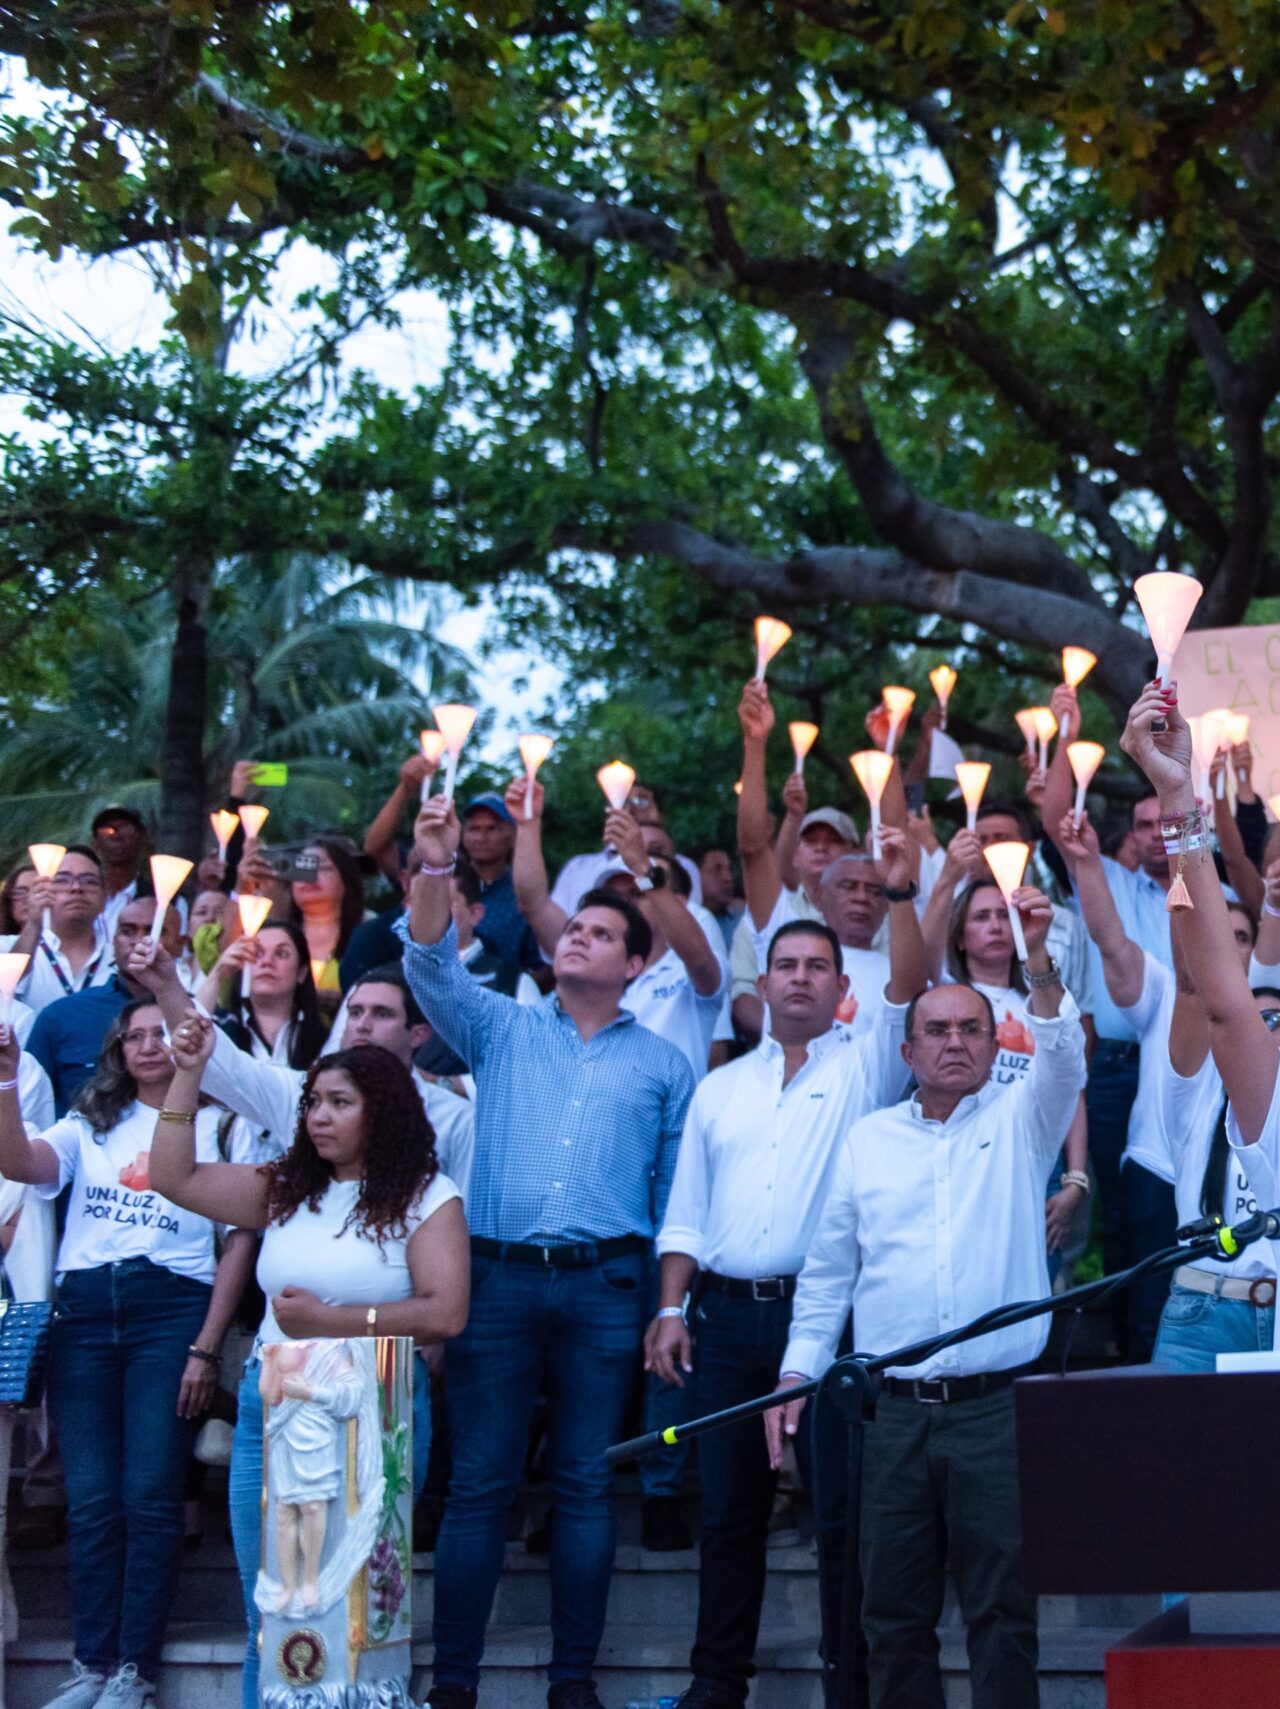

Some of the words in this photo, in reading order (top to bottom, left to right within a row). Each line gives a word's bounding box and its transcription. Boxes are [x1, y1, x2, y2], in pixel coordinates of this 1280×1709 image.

[1203, 641, 1242, 676] EL
[1000, 1053, 1031, 1072] LUZ
[86, 1186, 118, 1203] UNA
[121, 1192, 156, 1209] LUZ
[82, 1204, 112, 1220] POR
[114, 1208, 137, 1226] LA
